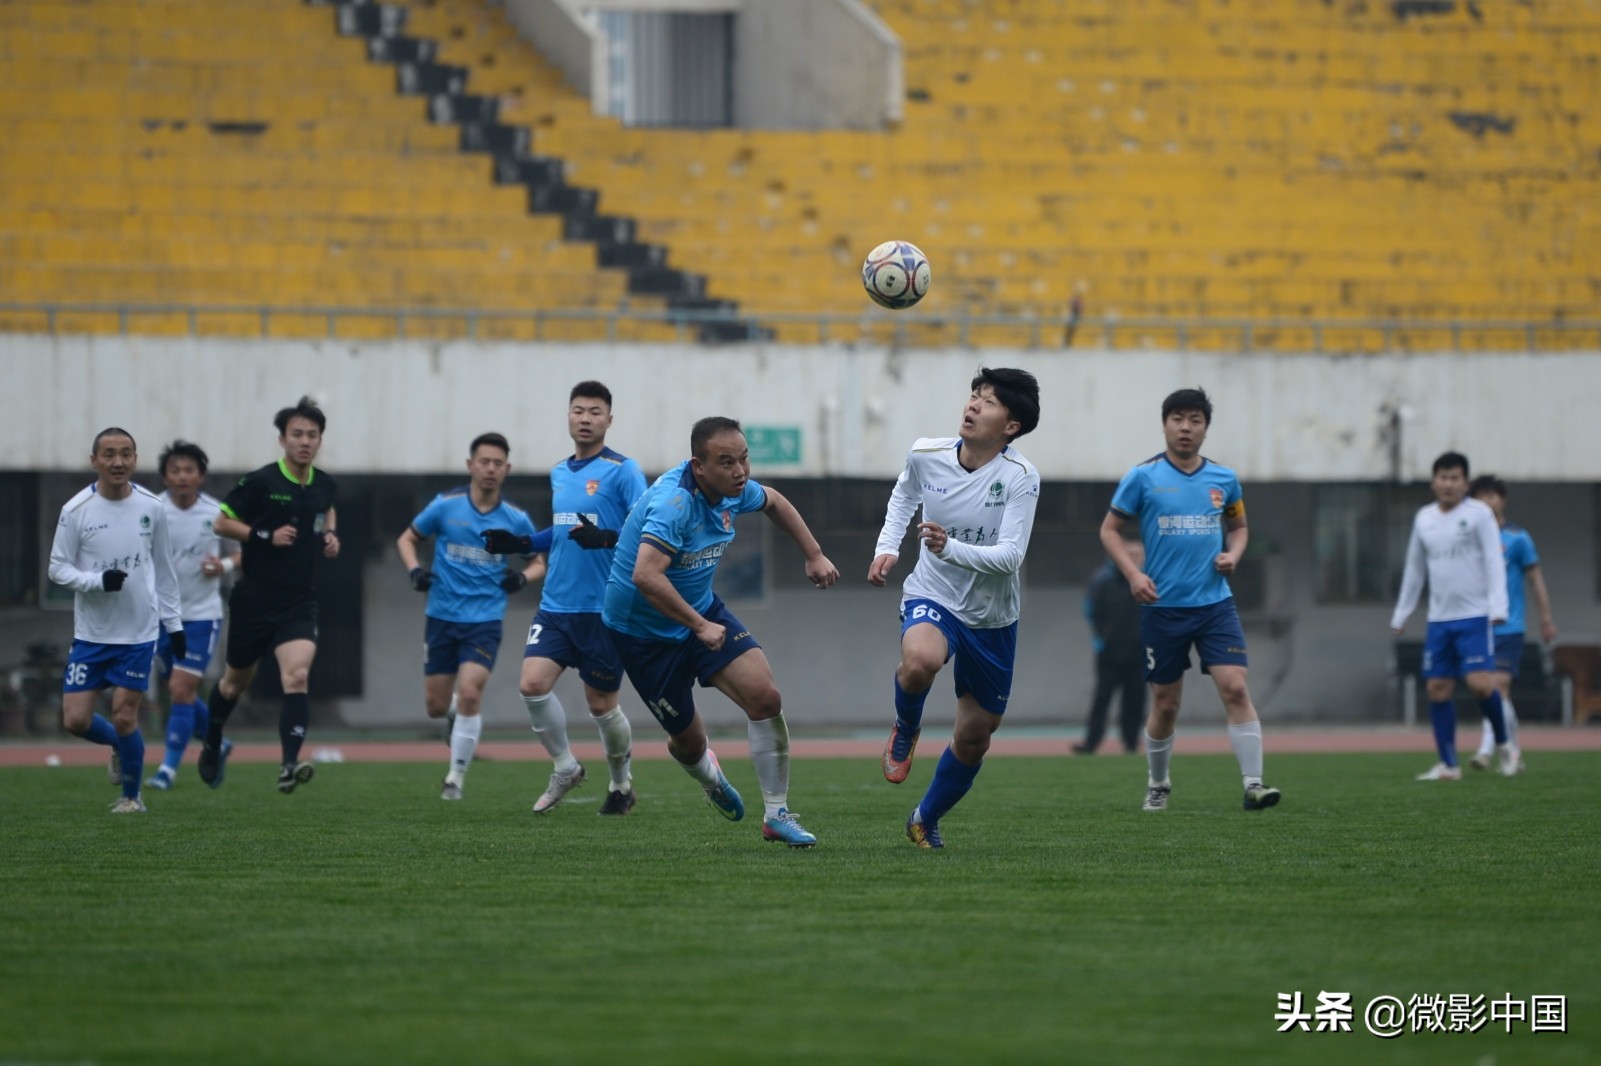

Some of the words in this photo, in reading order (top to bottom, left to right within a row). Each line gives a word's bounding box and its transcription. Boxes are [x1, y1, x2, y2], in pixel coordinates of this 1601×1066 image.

[923, 484, 949, 494] KELME
[912, 604, 941, 622] 60
[1146, 647, 1155, 670] 5
[66, 662, 88, 685] 36
